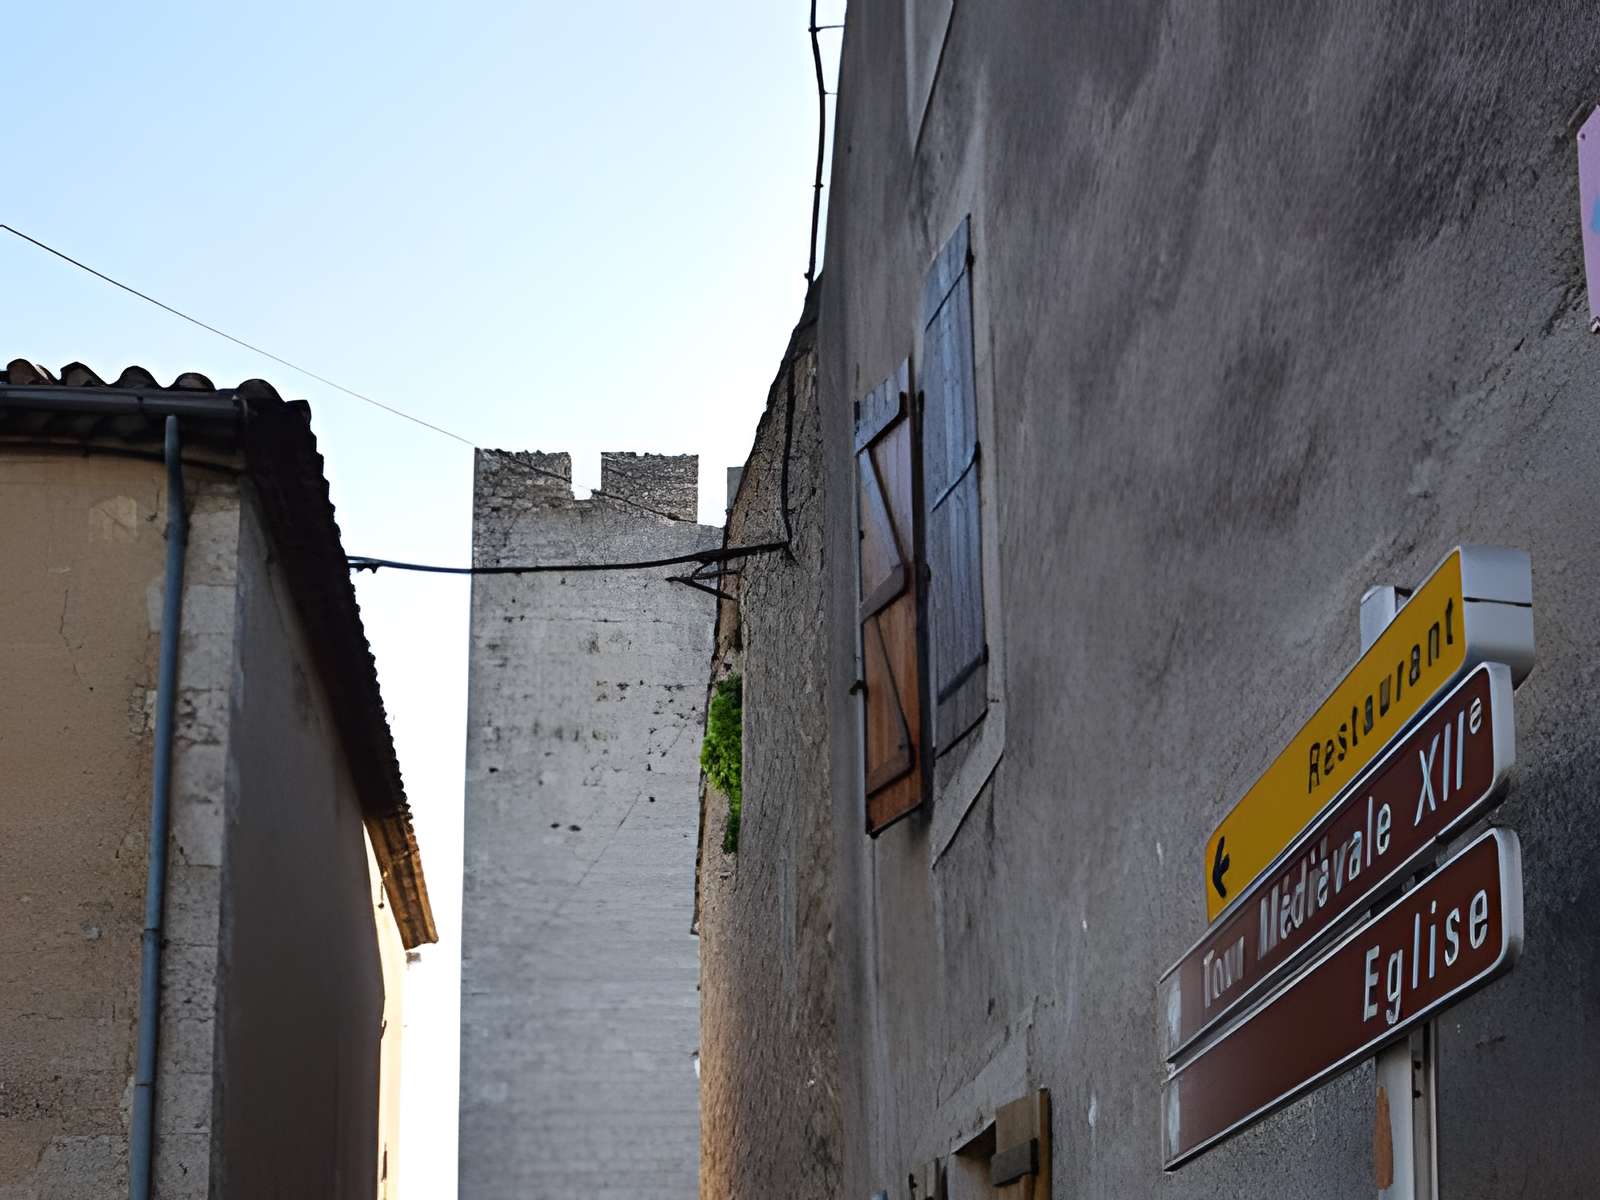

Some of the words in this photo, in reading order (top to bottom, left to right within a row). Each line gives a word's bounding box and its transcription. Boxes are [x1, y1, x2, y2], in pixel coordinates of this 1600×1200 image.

[1308, 597, 1454, 794] Restaurant
[1203, 935, 1245, 1008] Tour
[1363, 887, 1489, 1025] Eglise
